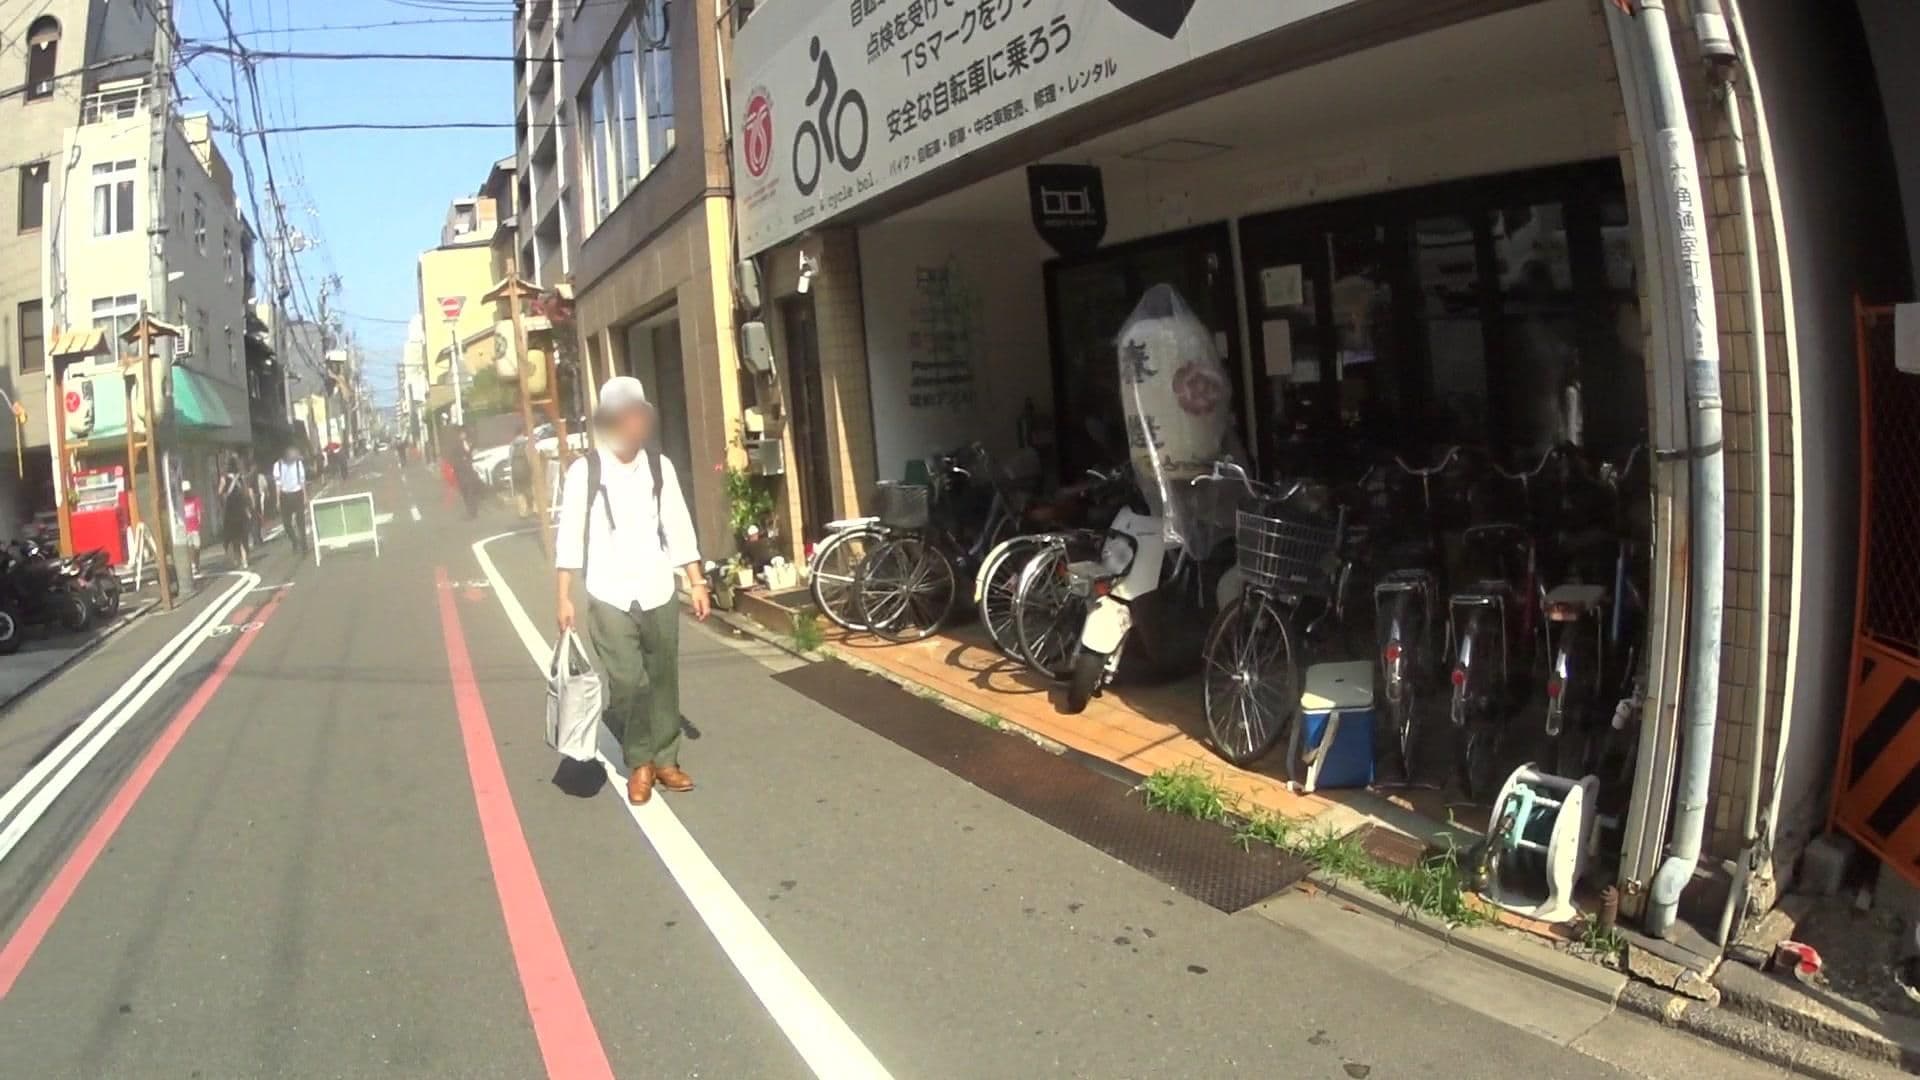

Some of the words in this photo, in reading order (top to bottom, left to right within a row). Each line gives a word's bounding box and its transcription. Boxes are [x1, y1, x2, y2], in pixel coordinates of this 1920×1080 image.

[867, 0, 955, 64] 点検を受け
[886, 14, 1072, 142] 安全な自転車に乗ろう
[827, 184, 853, 209] cycle
